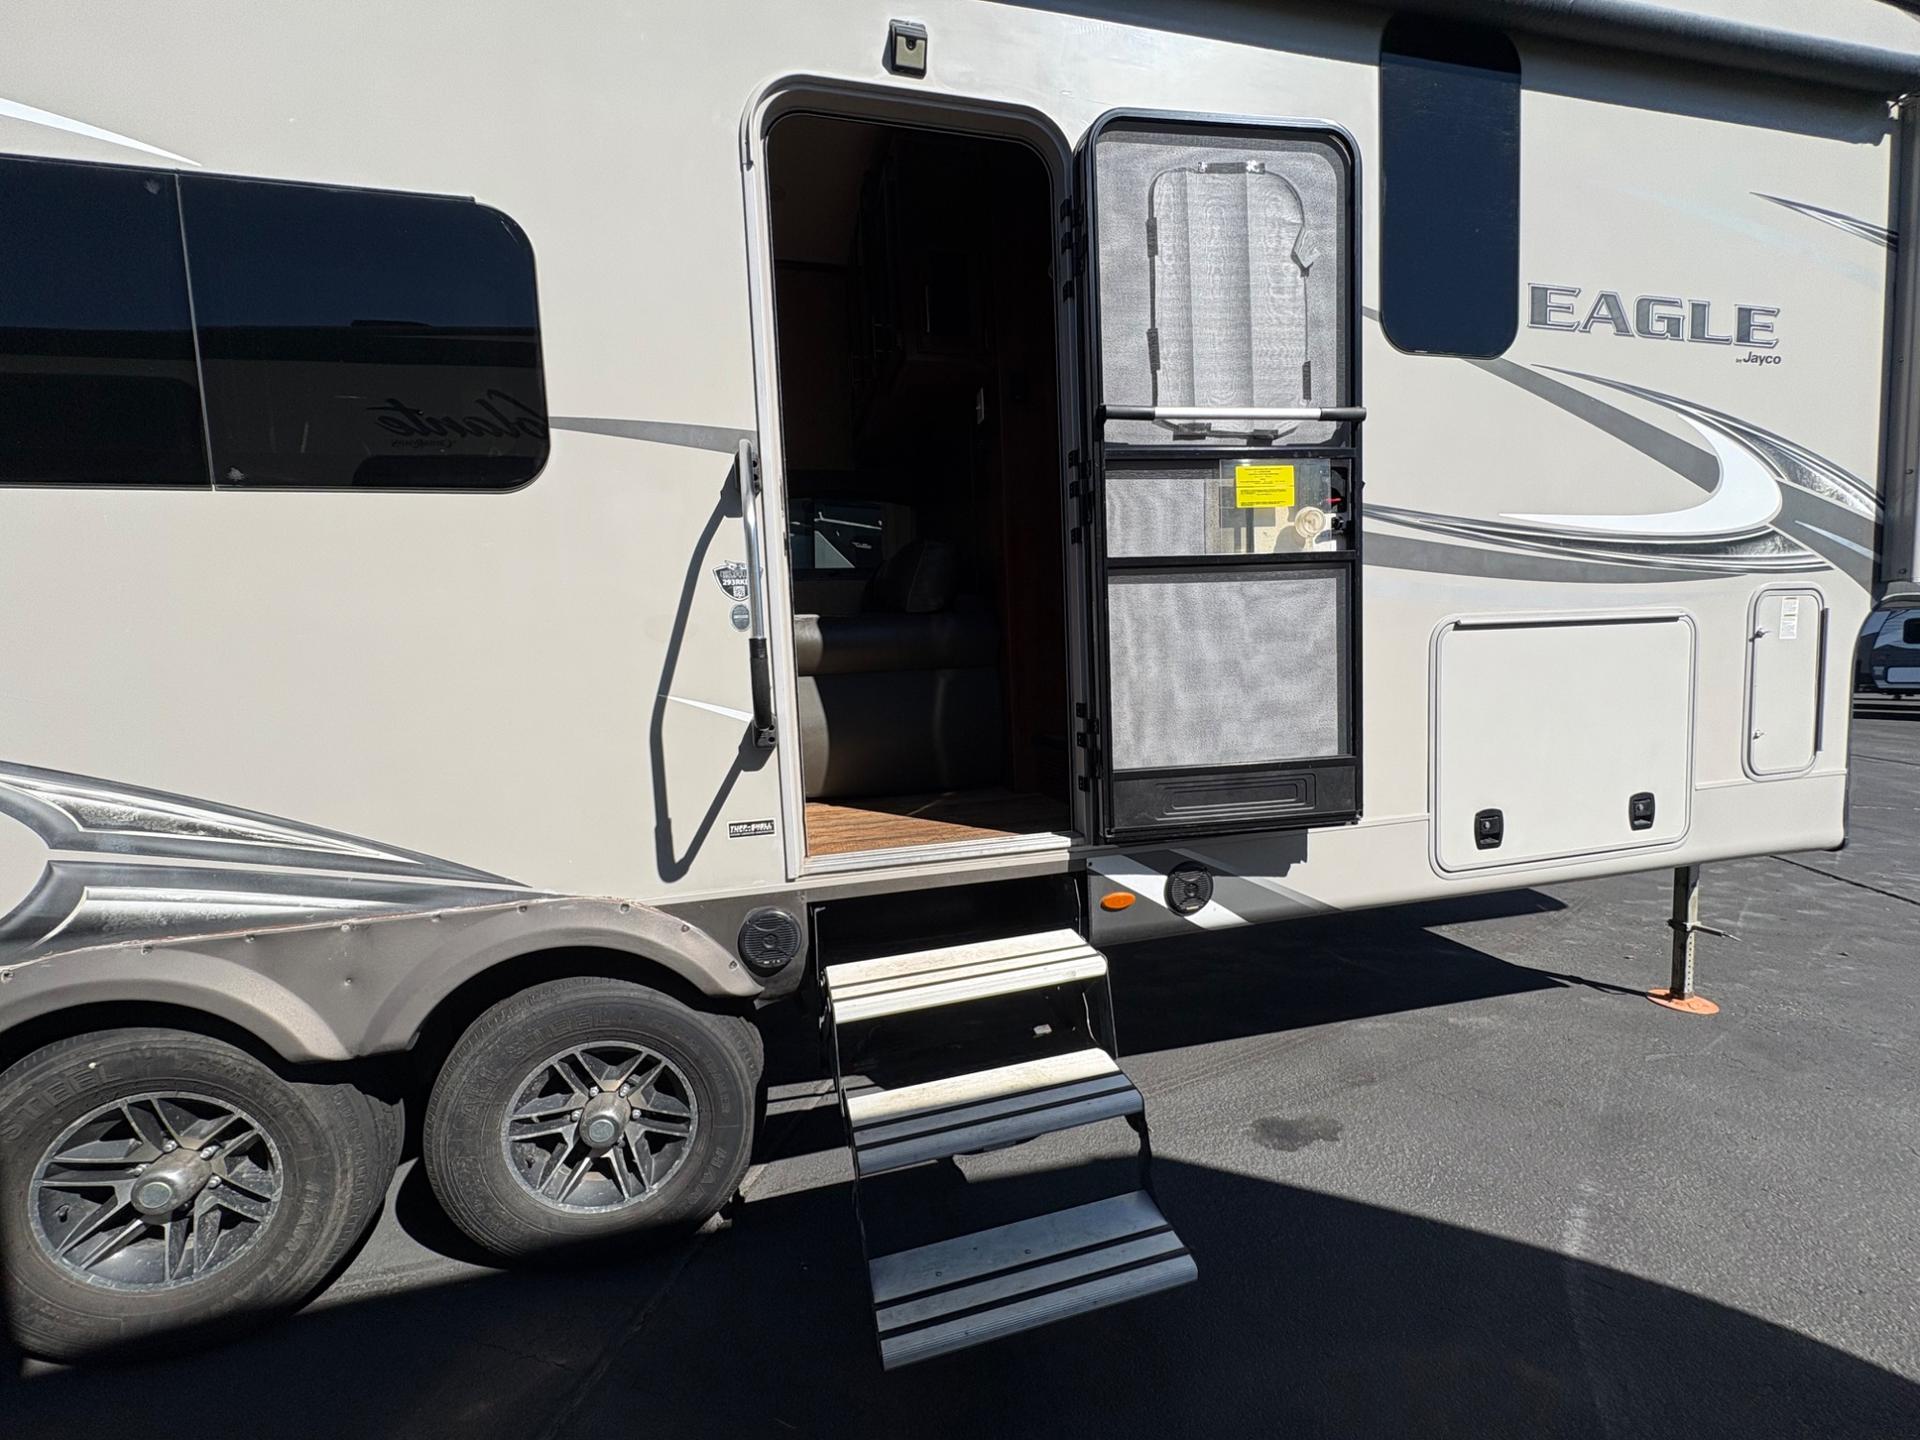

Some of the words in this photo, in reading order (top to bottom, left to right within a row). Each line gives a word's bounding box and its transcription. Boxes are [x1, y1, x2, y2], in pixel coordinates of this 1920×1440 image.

[1527, 282, 1781, 349] EAGLE
[1743, 351, 1782, 367] Jayco
[0, 1062, 124, 1141] STEEL
